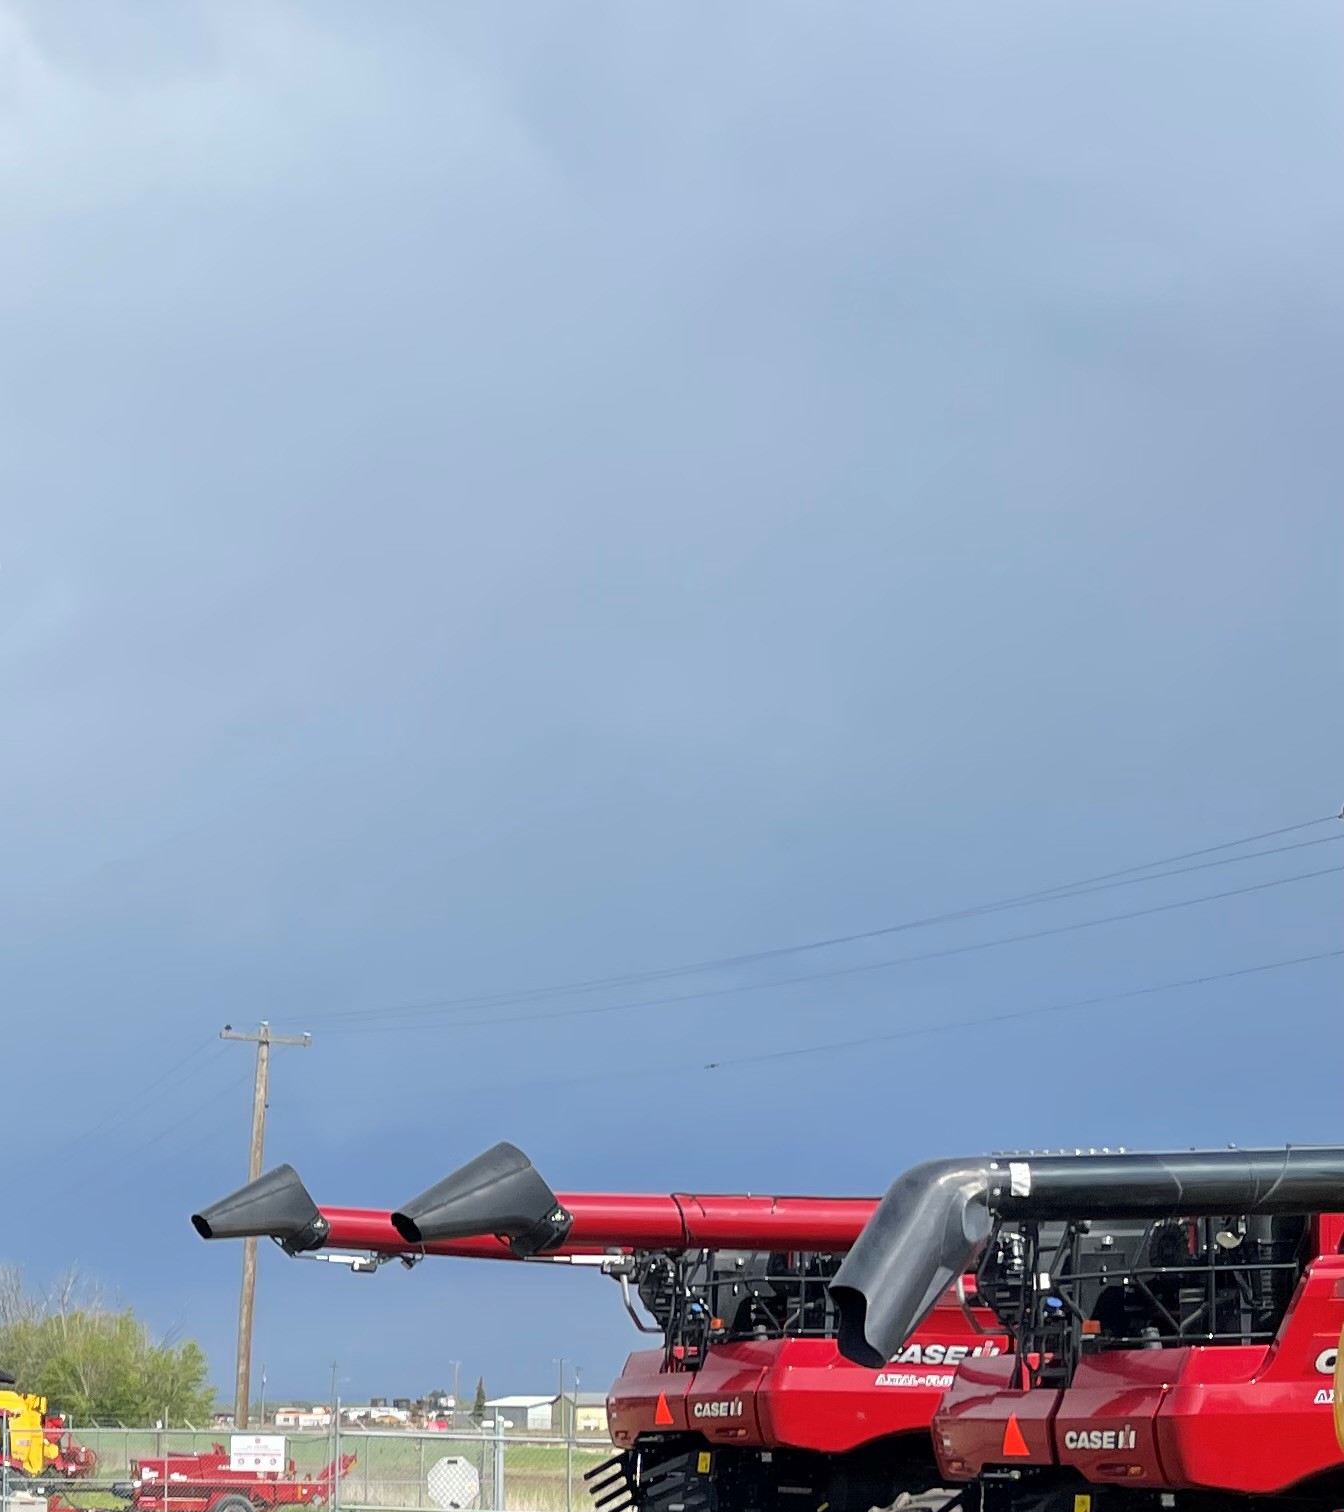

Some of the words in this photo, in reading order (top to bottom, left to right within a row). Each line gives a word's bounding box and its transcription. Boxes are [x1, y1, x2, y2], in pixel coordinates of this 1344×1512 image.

[890, 1343, 968, 1365] ASE
[875, 1373, 953, 1387] AXIAL-FLO
[694, 1401, 729, 1418] CASE
[1064, 1430, 1116, 1449] CASE
